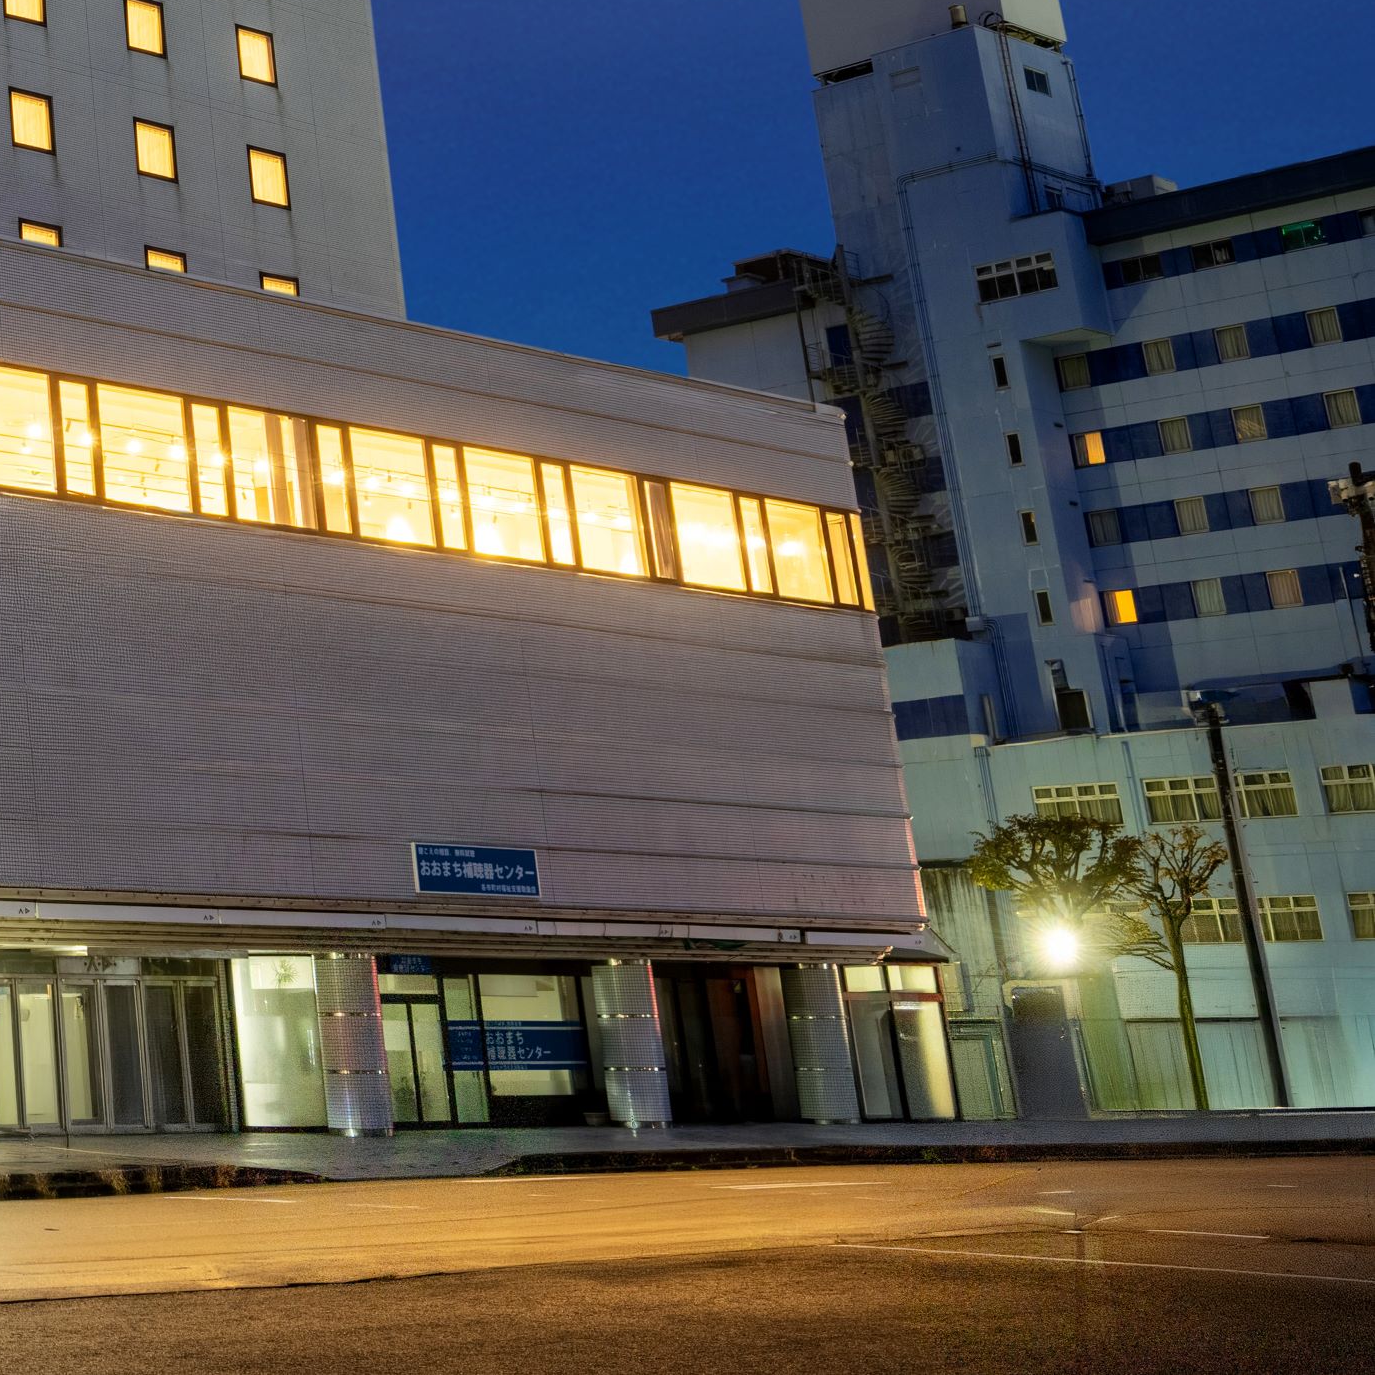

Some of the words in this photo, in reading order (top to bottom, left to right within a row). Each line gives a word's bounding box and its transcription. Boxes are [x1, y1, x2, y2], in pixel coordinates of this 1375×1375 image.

[419, 859, 535, 880] おおまち補聴器センター
[485, 1031, 524, 1045] おおまち
